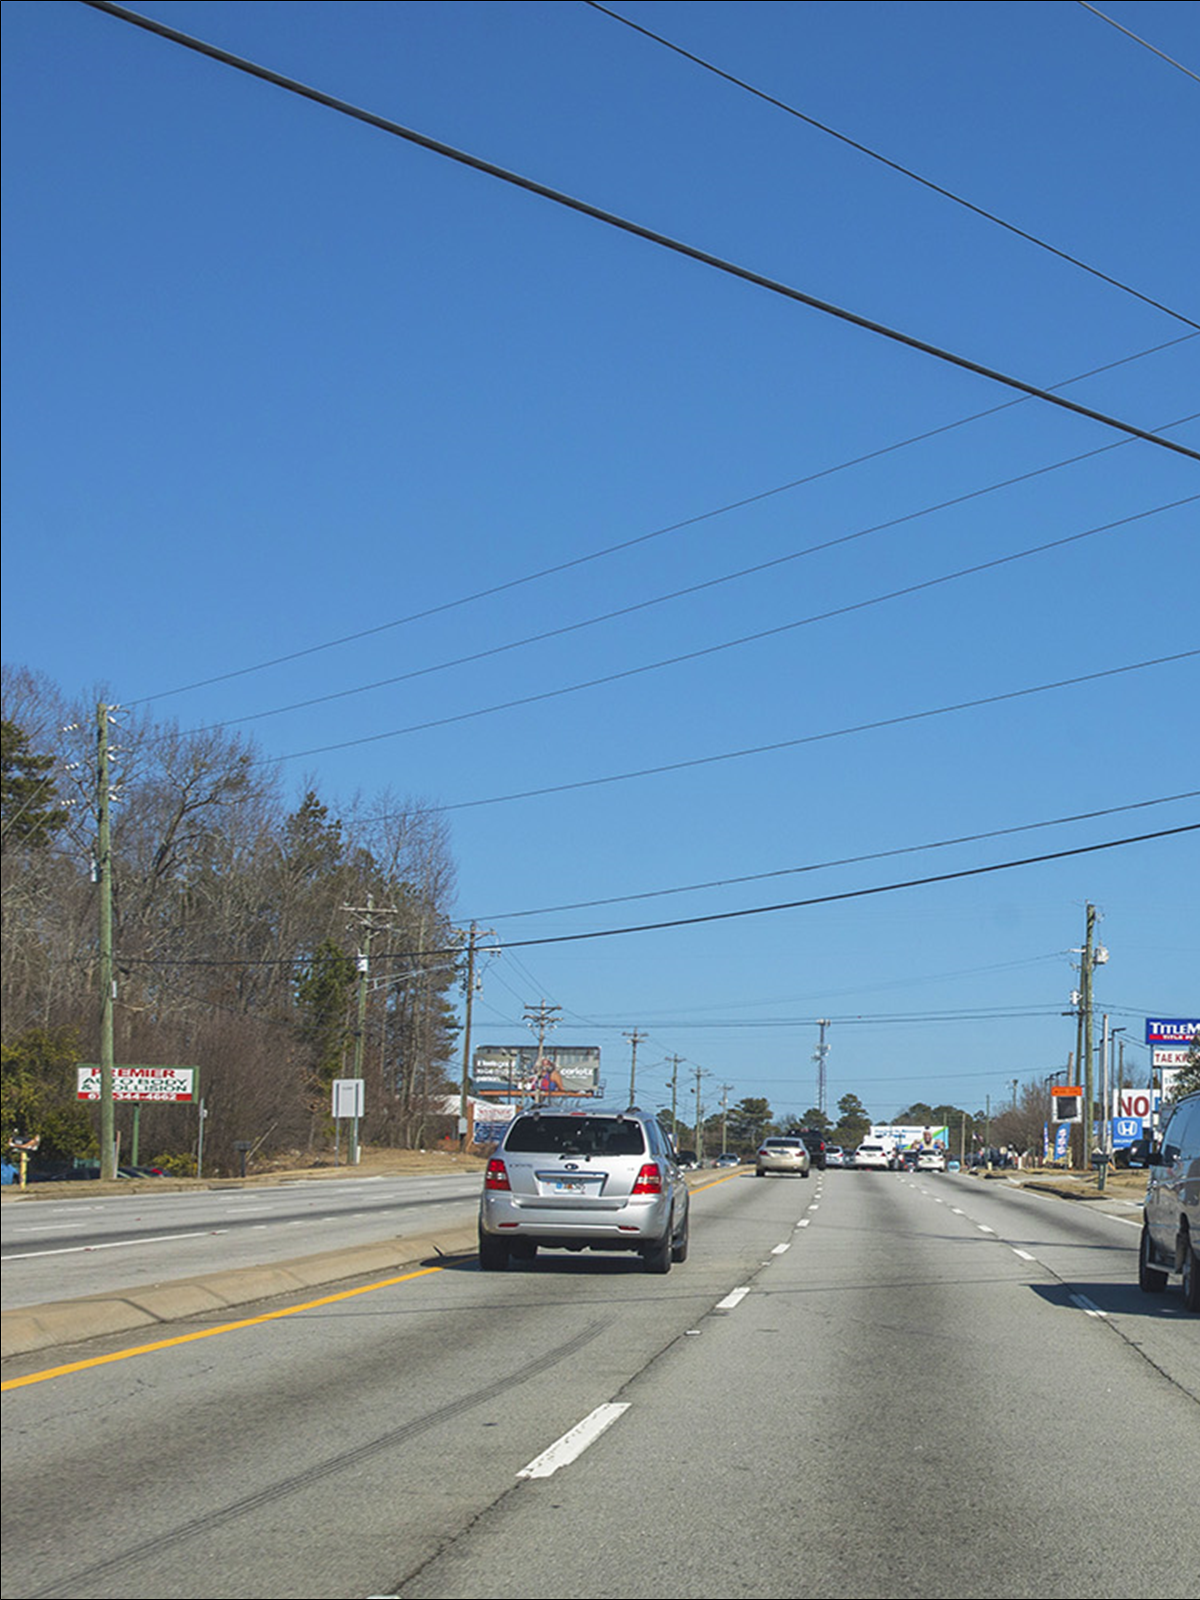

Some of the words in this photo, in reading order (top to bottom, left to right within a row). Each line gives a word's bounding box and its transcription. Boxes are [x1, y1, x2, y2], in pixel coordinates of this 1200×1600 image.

[1154, 1053, 1173, 1063] TAE
[91, 1068, 176, 1078] PEMIER
[1120, 1096, 1150, 1117] NO
